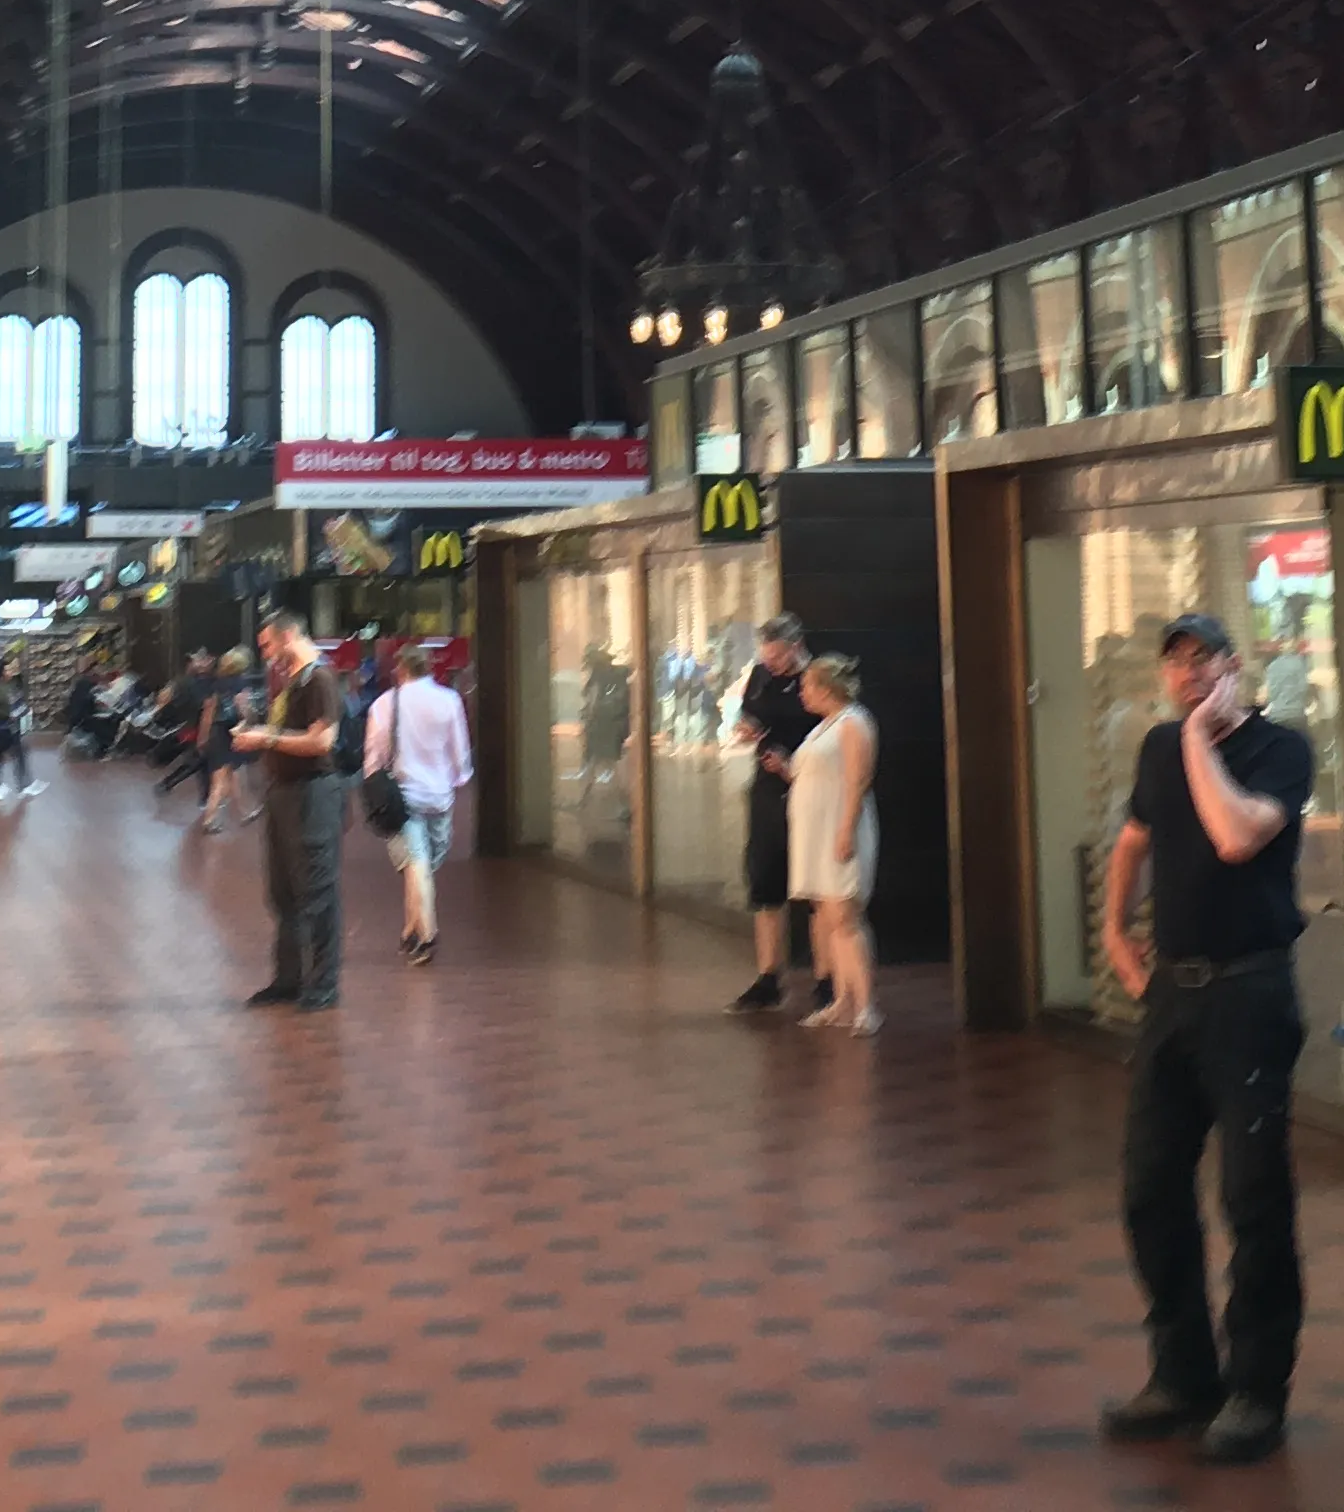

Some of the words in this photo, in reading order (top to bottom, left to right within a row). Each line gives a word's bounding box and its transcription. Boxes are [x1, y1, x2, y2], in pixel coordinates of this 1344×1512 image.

[293, 447, 388, 472] Billetter
[390, 447, 419, 471] til
[472, 447, 516, 471] bus
[540, 449, 611, 470] metro
